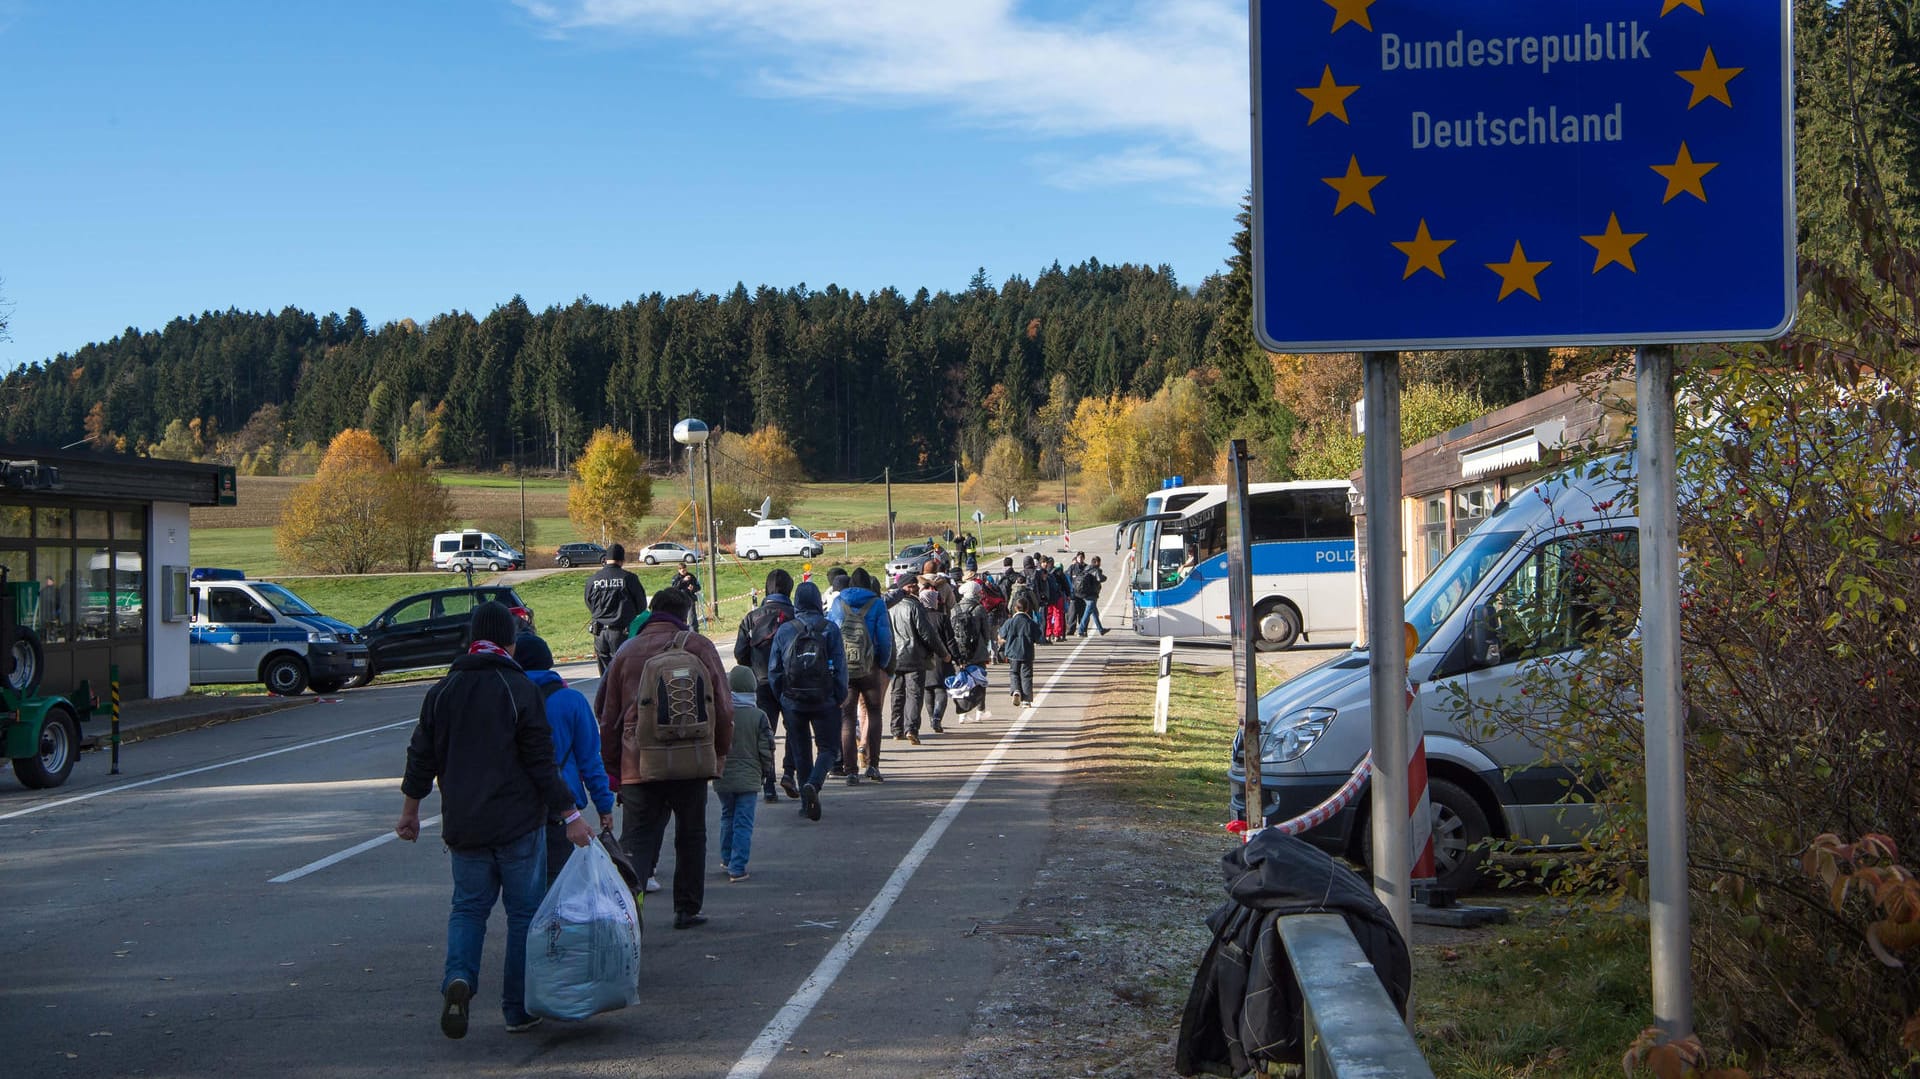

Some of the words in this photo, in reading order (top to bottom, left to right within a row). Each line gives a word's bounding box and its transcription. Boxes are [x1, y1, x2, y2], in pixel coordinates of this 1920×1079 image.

[1381, 21, 1651, 73] Bundesrepublik
[1412, 103, 1623, 149] Deutschland
[593, 578, 624, 589] POLIZEI
